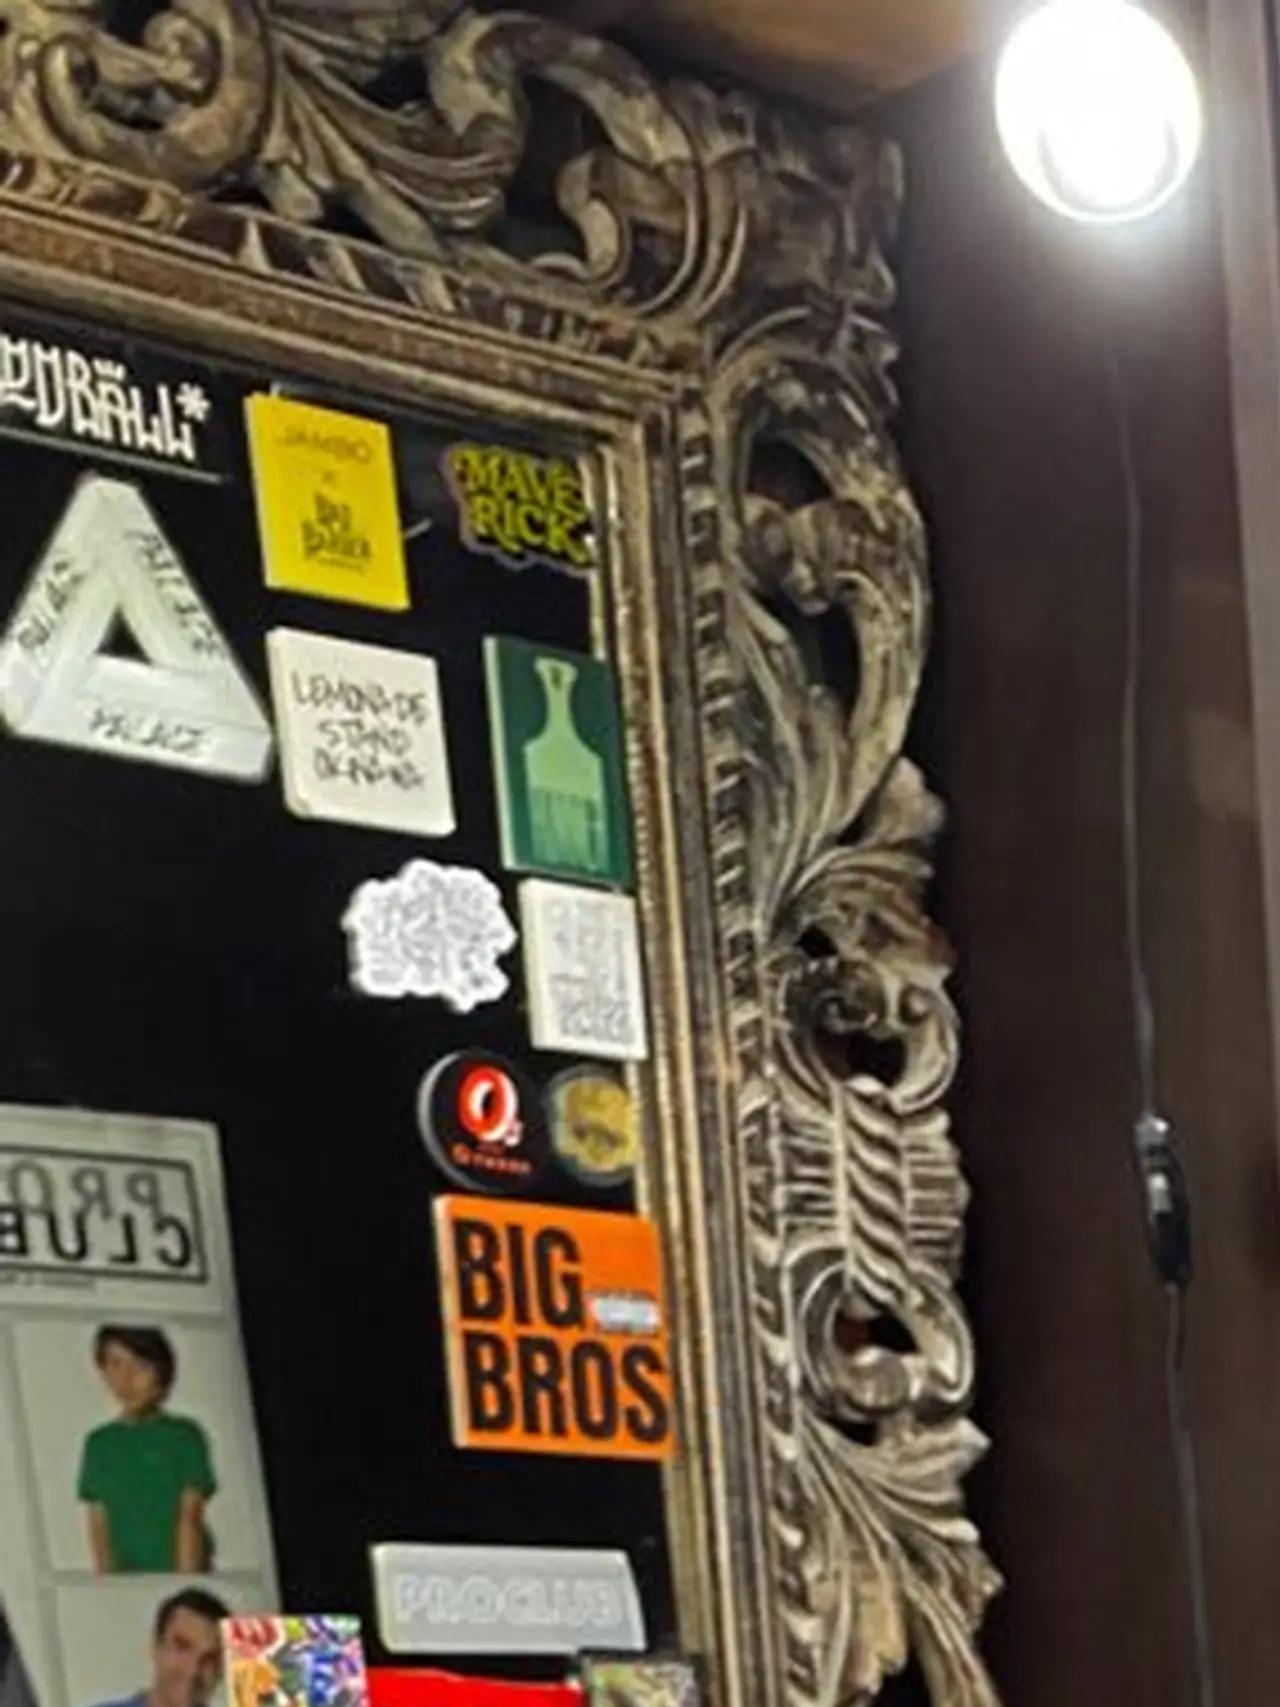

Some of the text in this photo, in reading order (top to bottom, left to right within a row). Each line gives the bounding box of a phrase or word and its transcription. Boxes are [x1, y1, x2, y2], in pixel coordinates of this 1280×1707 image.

[468, 497, 589, 563] RICK
[452, 1217, 585, 1329] BIG
[464, 1331, 669, 1444] BROS
